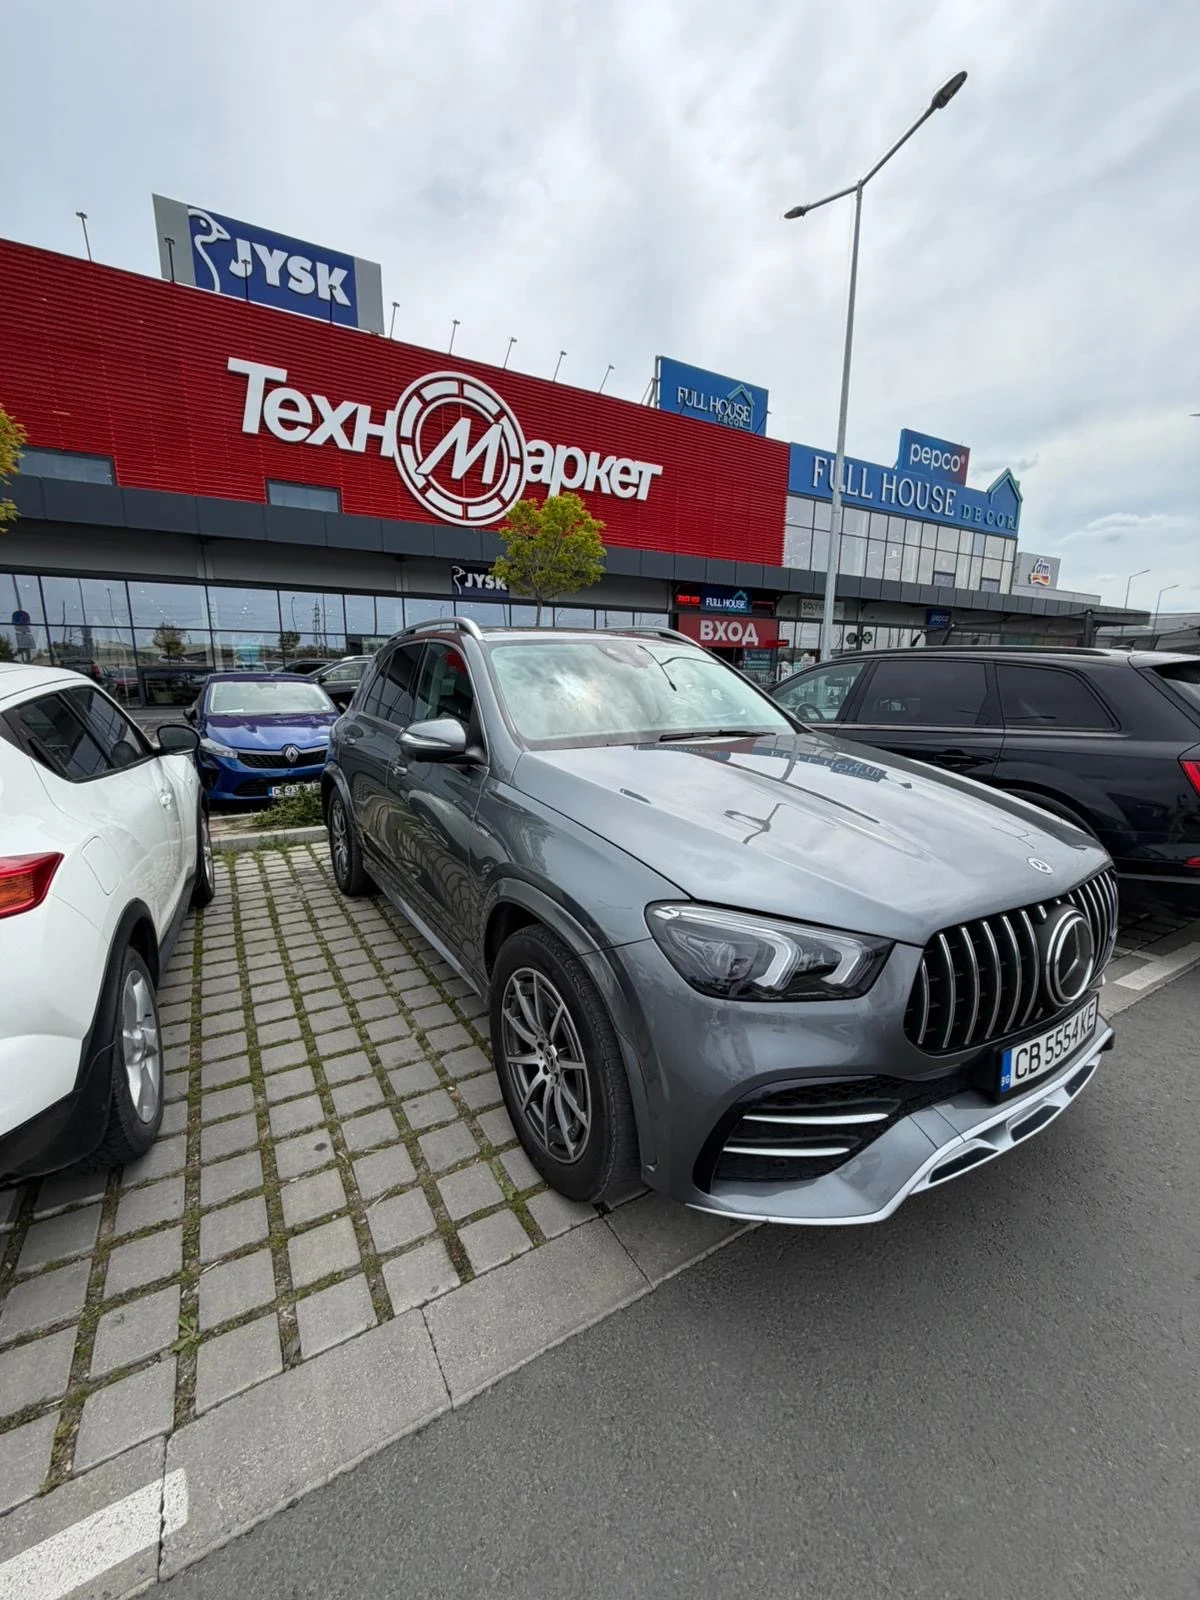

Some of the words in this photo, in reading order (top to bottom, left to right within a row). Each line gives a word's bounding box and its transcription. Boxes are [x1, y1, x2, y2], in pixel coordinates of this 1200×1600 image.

[229, 238, 351, 306] JYSK
[677, 386, 708, 411] FULL
[709, 395, 751, 422] HOUSE
[881, 472, 957, 517] HOUSE
[961, 503, 1017, 530] DECOR
[464, 573, 508, 591] JYSK
[705, 597, 723, 608] FULL
[722, 599, 747, 610] HOUSE
[700, 619, 760, 647] ВХОД
